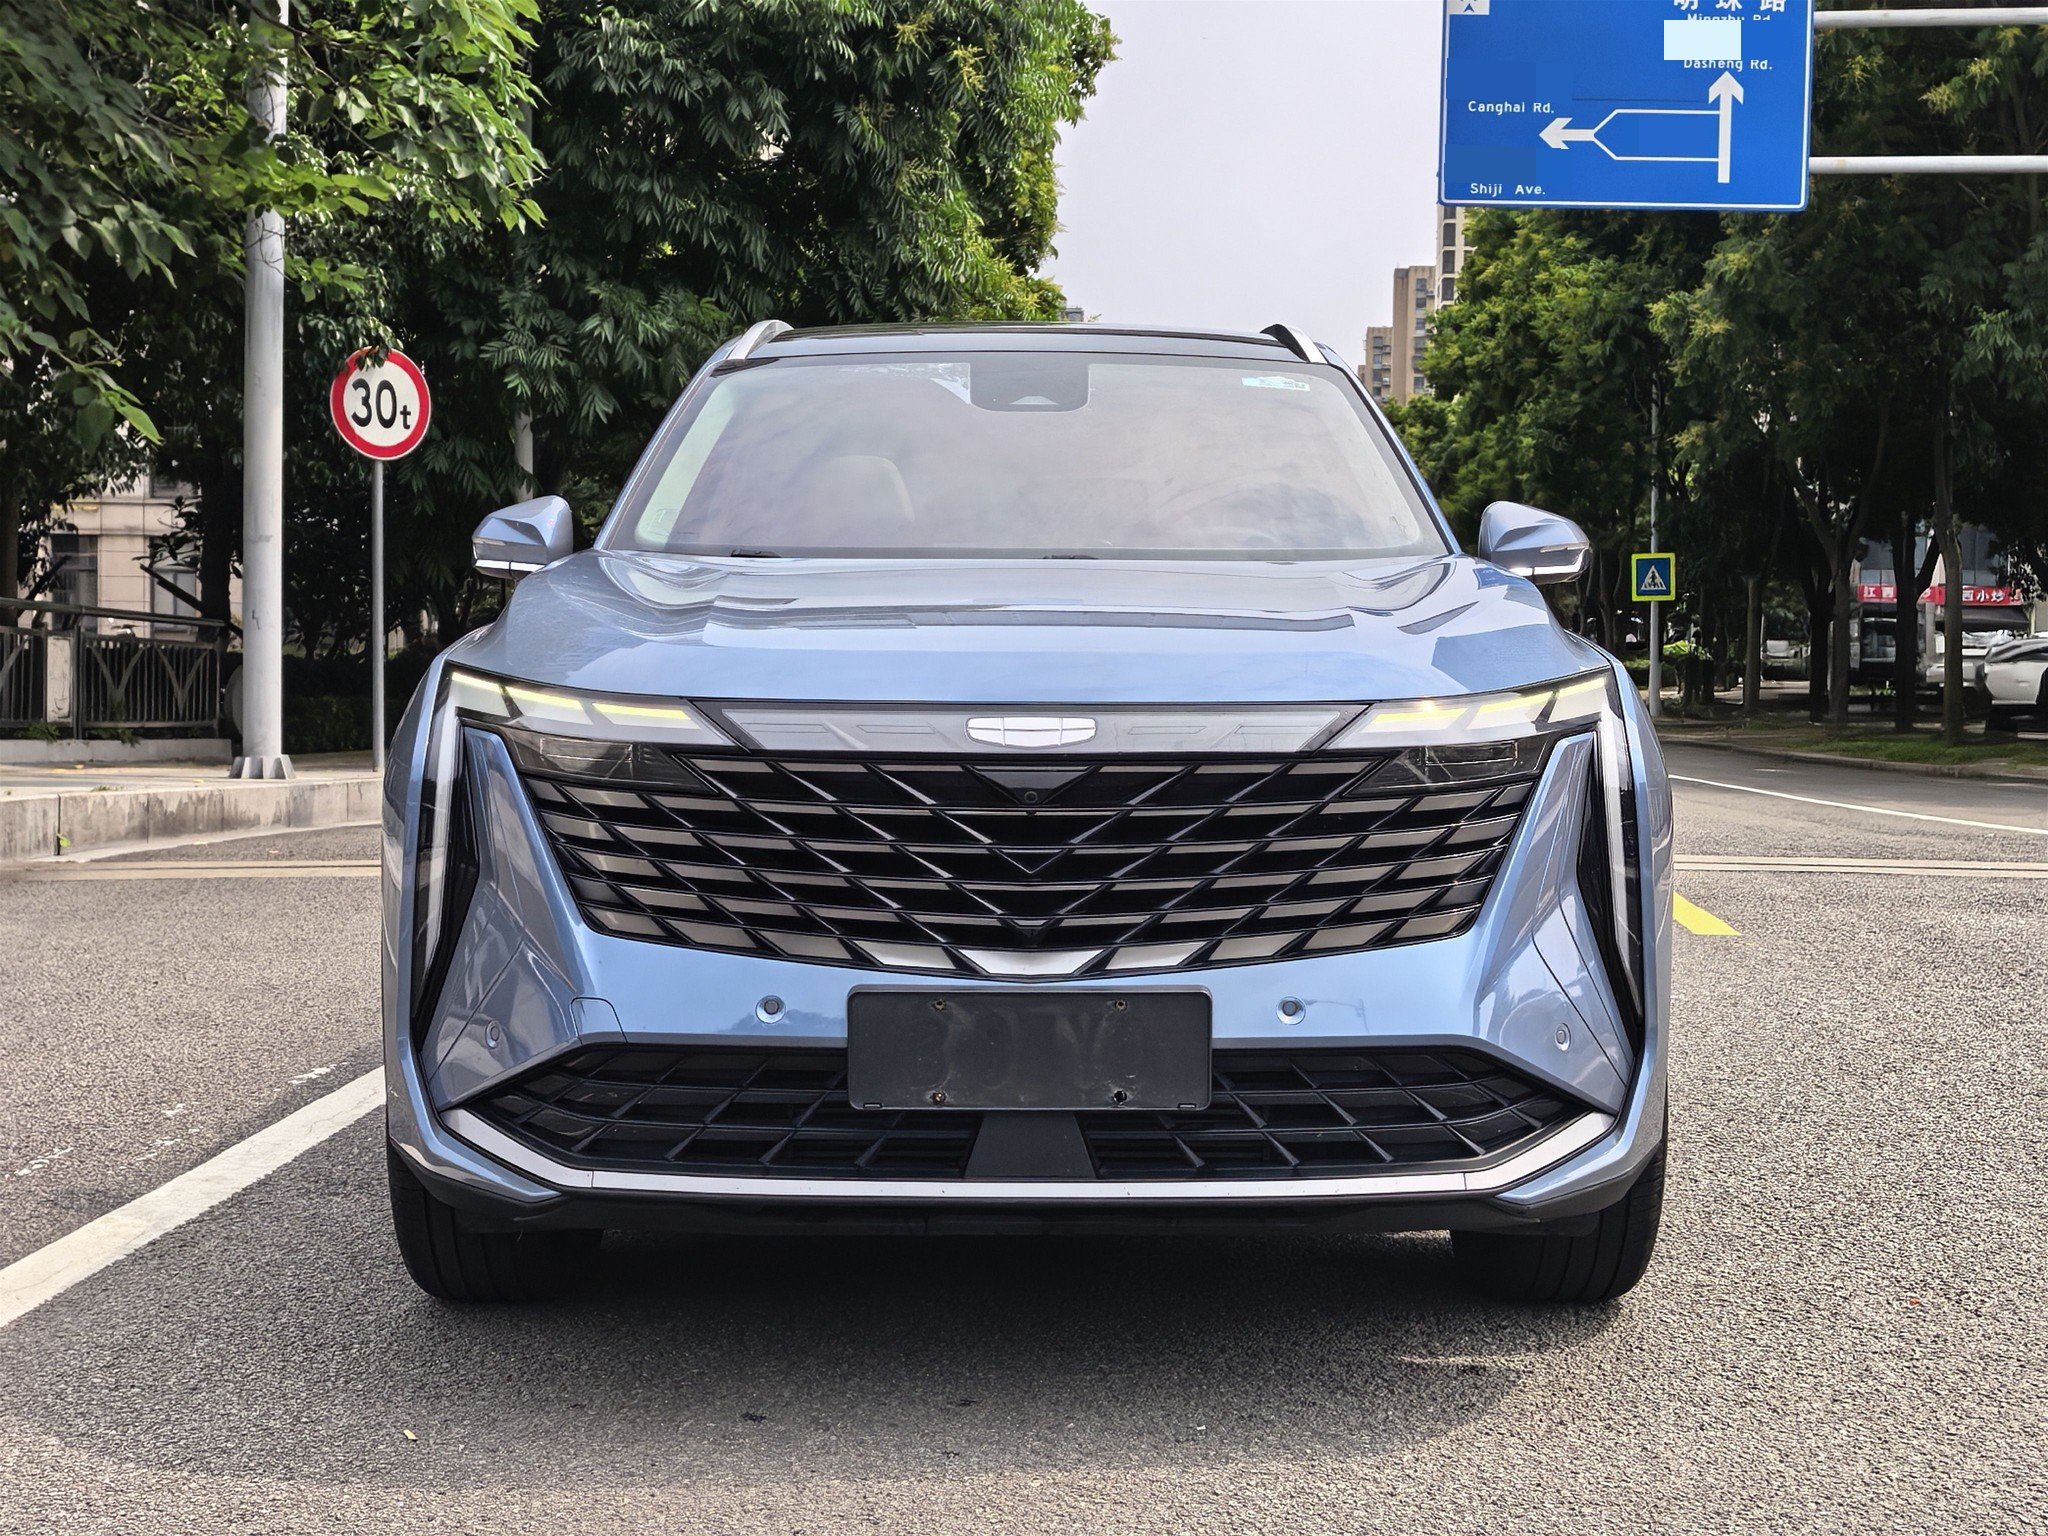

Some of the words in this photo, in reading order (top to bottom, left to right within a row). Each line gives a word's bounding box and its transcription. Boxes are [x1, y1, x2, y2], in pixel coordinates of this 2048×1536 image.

[1683, 60, 1743, 72] Dasheng
[1750, 60, 1773, 70] Rd.
[1533, 102, 1555, 114] Rd.
[1470, 182, 1502, 198] Shiji
[1514, 184, 1546, 195] Ave.
[351, 378, 411, 430] 30t
